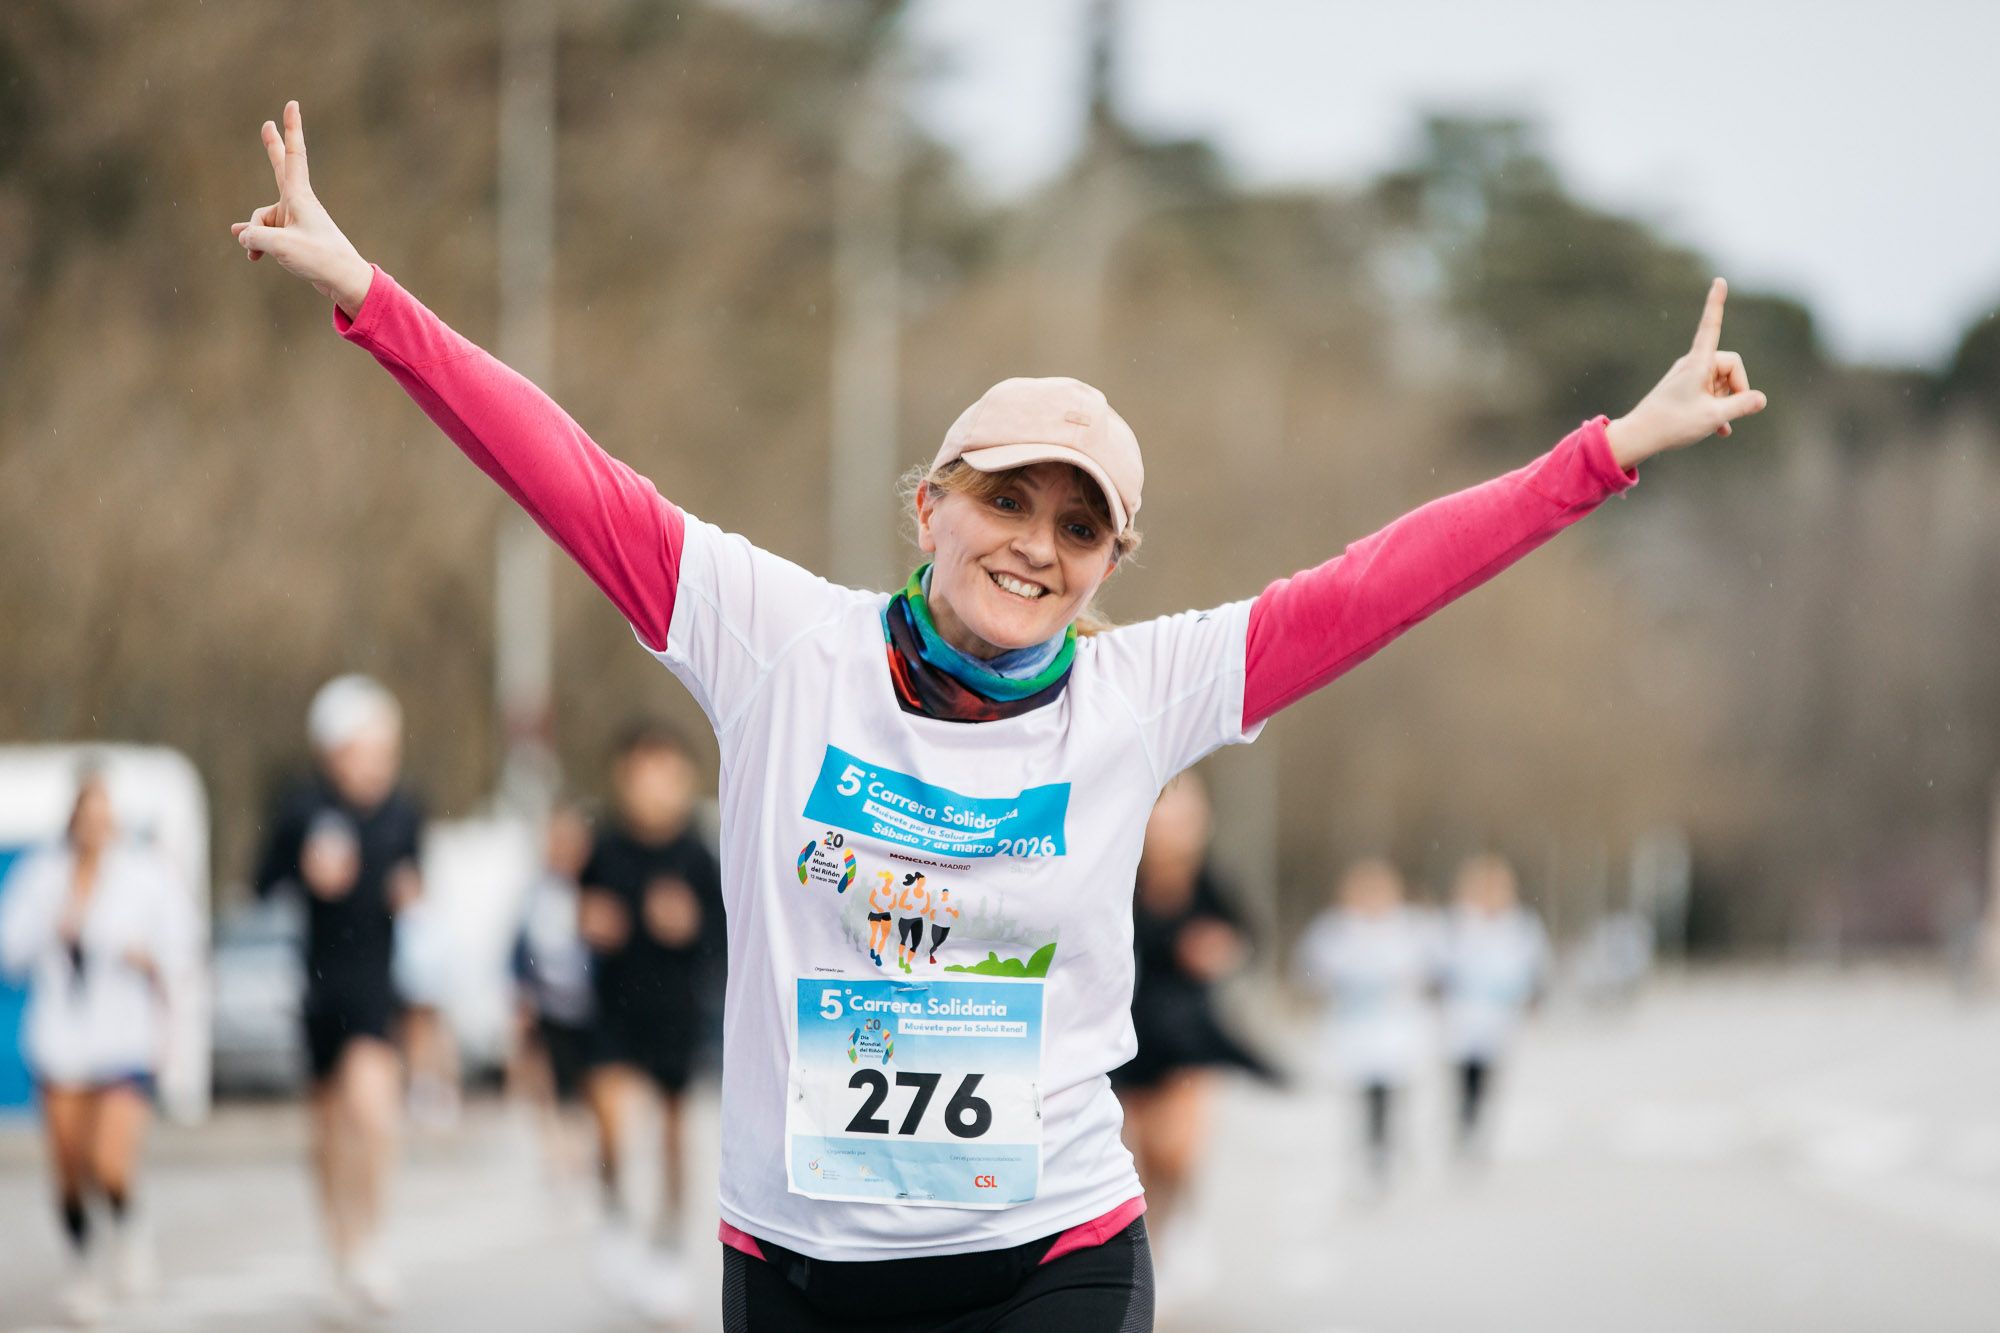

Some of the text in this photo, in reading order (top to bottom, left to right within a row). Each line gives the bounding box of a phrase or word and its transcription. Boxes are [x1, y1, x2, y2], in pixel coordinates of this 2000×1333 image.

[868, 781, 936, 819] Carrera
[872, 822, 1056, 858] Sábado 7 de marzo 2026
[909, 823, 925, 833] por
[927, 827, 936, 836] la
[940, 830, 965, 840] Salud
[812, 858, 839, 869] Mundial
[890, 853, 971, 871] MONCLOA MADRID
[849, 995, 922, 1015] Carrera
[927, 997, 1007, 1017] Solidaria
[946, 1025, 961, 1033] por
[964, 1024, 973, 1032] la
[975, 1025, 999, 1033] Salud
[1000, 1025, 1023, 1033] Renal
[844, 1068, 993, 1139] 276
[974, 1175, 998, 1188] CSL
